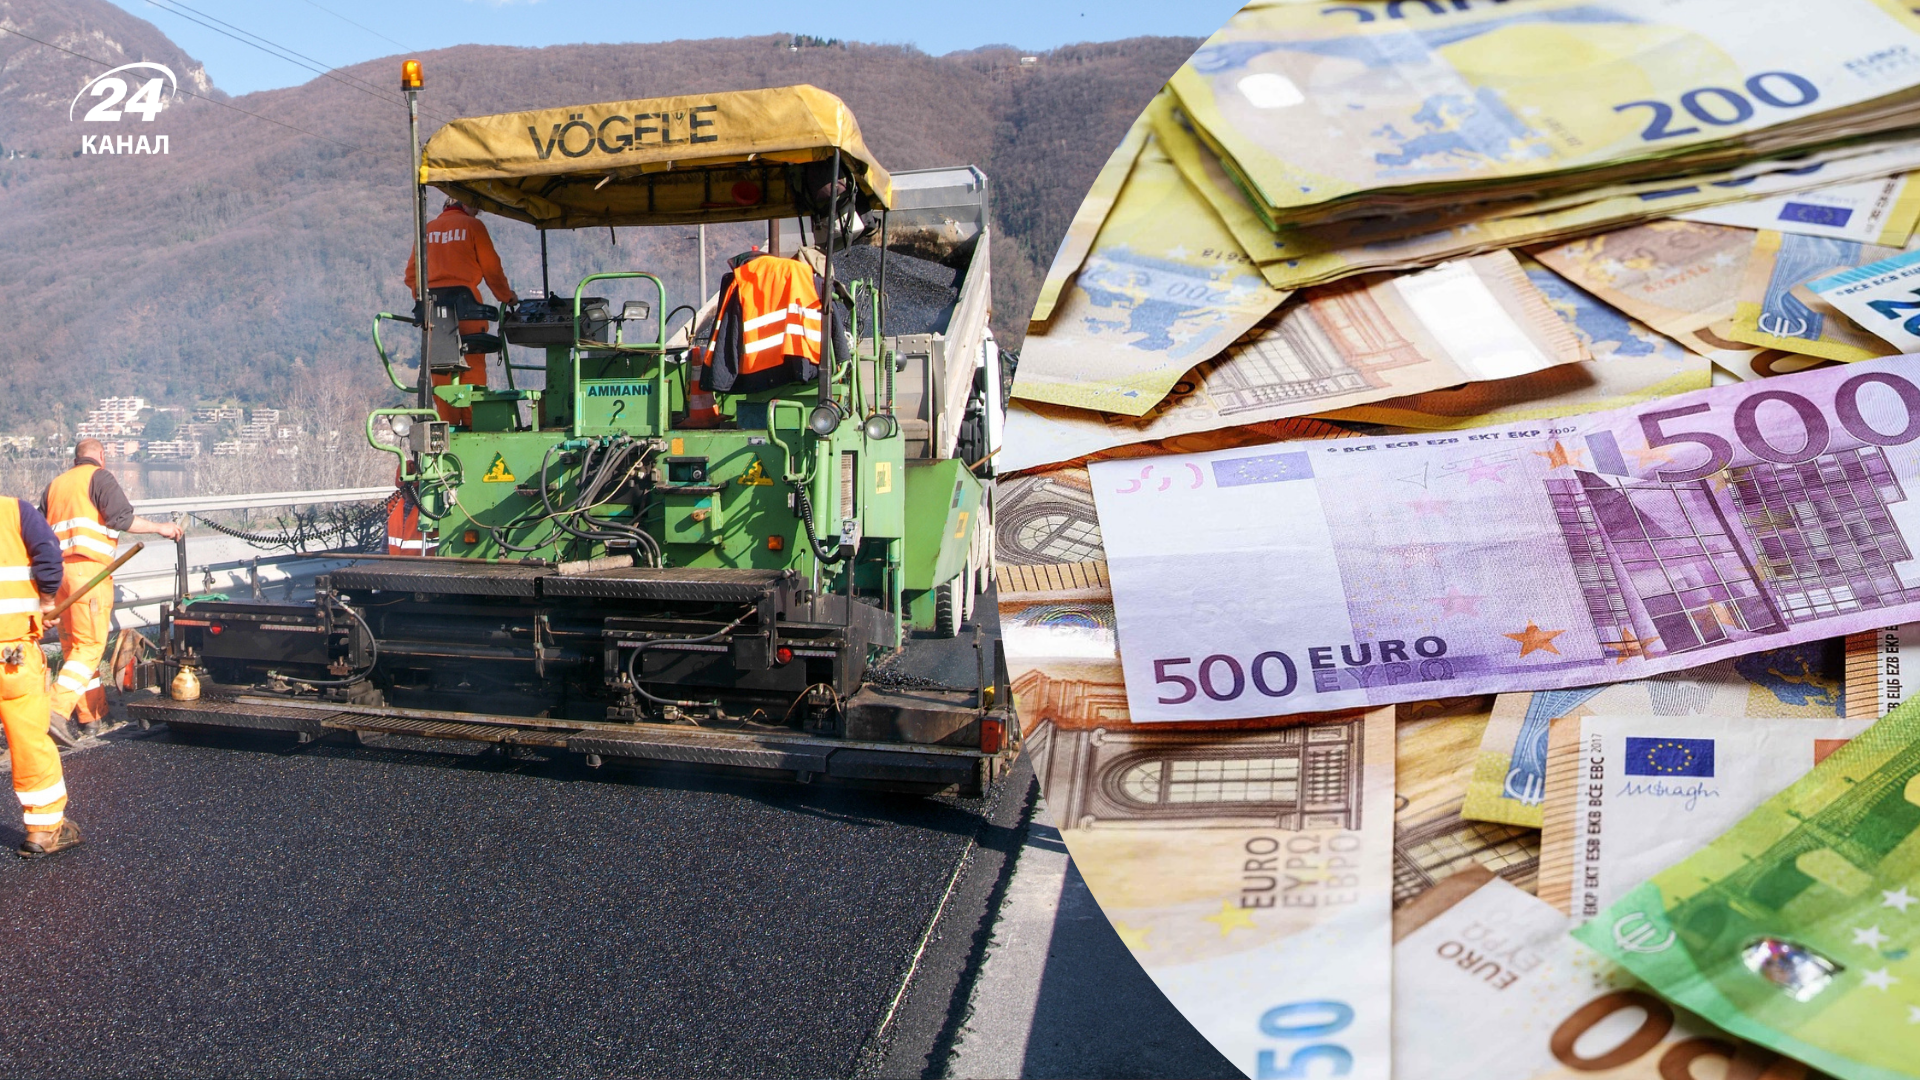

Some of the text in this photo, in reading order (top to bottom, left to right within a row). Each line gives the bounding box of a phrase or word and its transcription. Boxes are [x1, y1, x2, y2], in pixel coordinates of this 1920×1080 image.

[1613, 72, 1819, 141] 200
[528, 105, 717, 159] VÖGELE
[427, 229, 466, 243] ITELLI
[587, 385, 652, 397] AMMANN
[1343, 445, 1377, 453] BCE
[1386, 440, 1419, 449] ECB
[1427, 437, 1459, 446] EZB
[1468, 432, 1500, 441] EKT
[1508, 429, 1541, 439] EKP
[1548, 425, 1577, 435] 2002
[1638, 372, 1920, 483] 500
[1885, 634, 1900, 654] EKP
[1153, 636, 1448, 705] 500 EURO
[1886, 657, 1900, 675] EZB
[1591, 733, 1602, 753] 2017
[1590, 757, 1605, 780] EBC
[1241, 836, 1280, 909] EURO
[1437, 940, 1519, 990] EURO
[1257, 999, 1356, 1080] 50
